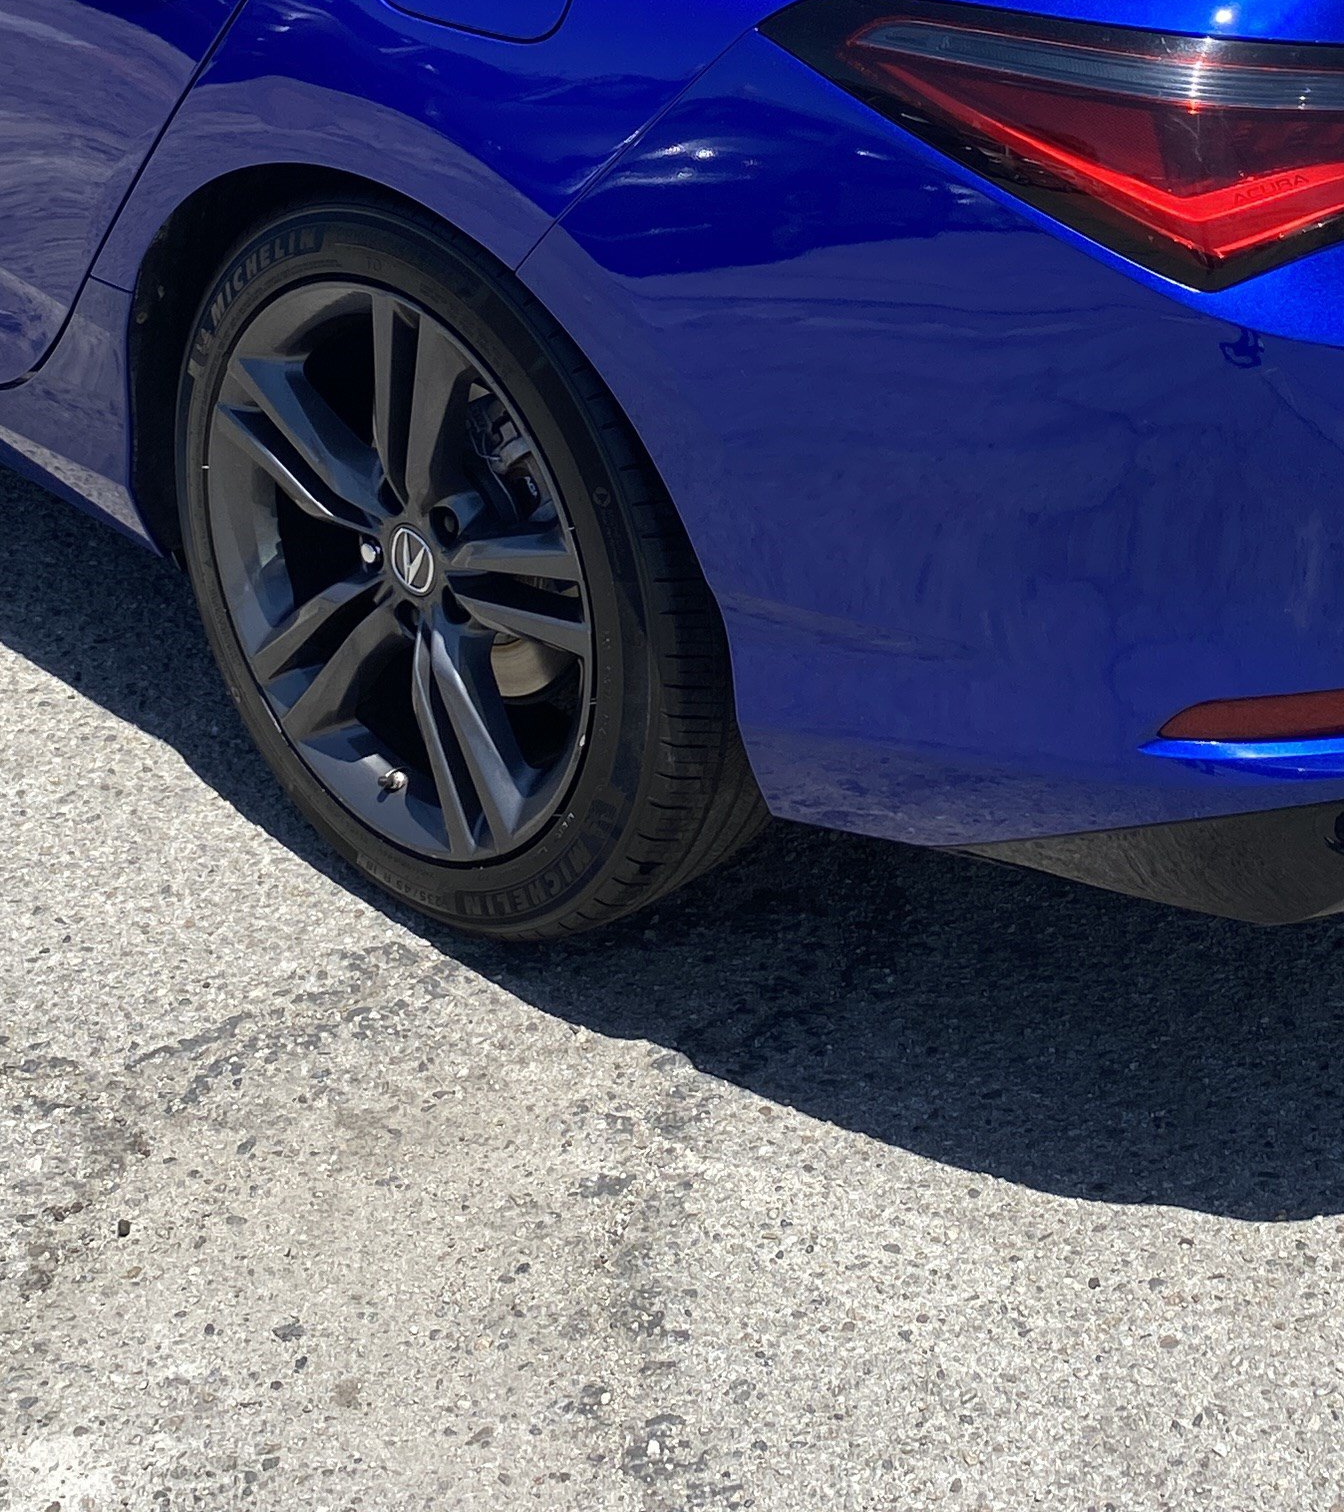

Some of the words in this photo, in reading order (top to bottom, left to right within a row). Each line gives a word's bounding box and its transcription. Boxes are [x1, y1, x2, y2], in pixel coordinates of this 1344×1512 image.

[1233, 174, 1310, 206] ACURA
[210, 227, 315, 327] MICHELIN
[463, 837, 591, 916] MICHELIN
